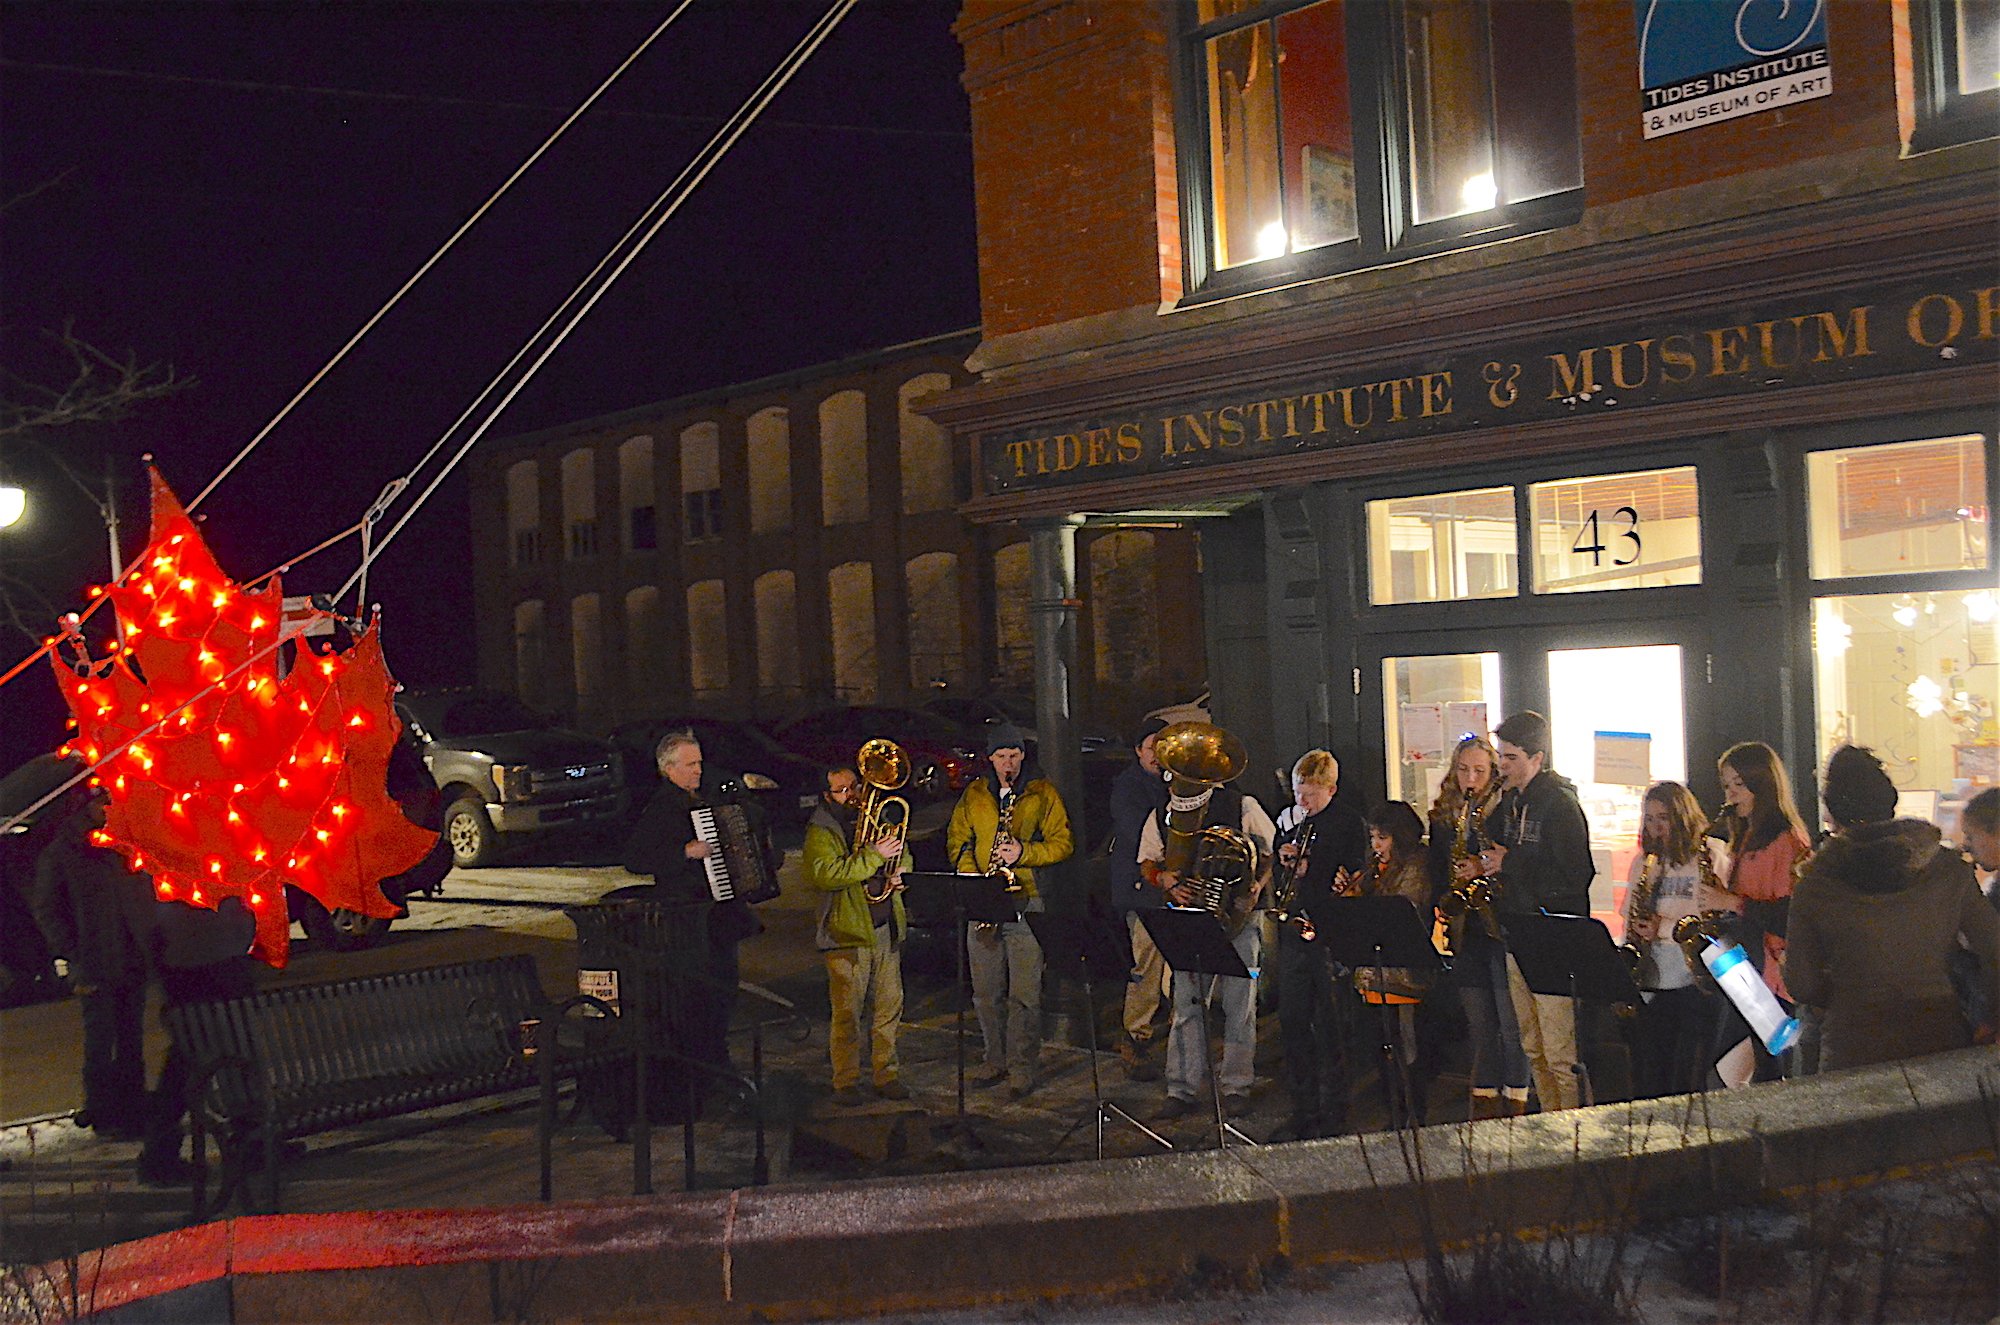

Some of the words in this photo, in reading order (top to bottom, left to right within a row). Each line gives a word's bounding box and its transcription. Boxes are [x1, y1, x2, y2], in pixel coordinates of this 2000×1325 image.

[1646, 79, 1709, 107] TIDES
[1713, 48, 1827, 90] INSTITUTE
[1651, 116, 1664, 130] &
[1669, 95, 1749, 126] MUSEUM
[1755, 87, 1781, 104] OF
[1787, 76, 1827, 97] ART
[1007, 423, 1142, 478] TIDES
[1159, 371, 1453, 458] INSTITUTE
[1483, 361, 1521, 408] &
[1545, 305, 1876, 400] MUSEUM
[1572, 506, 1641, 566] 43
